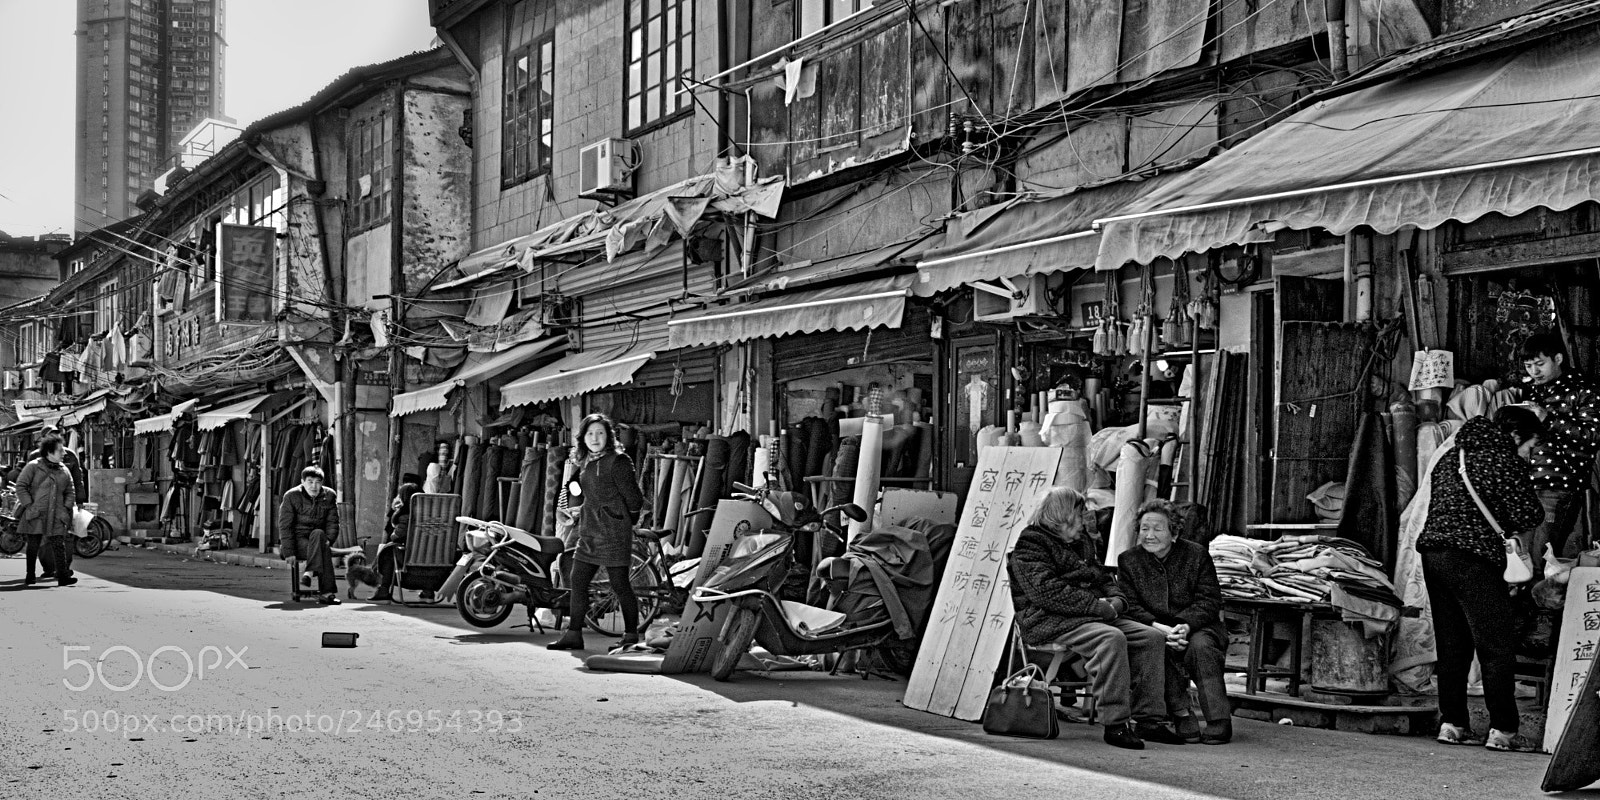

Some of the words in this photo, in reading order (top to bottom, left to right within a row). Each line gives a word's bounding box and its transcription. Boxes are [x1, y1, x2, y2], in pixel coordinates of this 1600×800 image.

[980, 468, 1048, 497] 窗帘布
[957, 536, 1014, 562] 遮光
